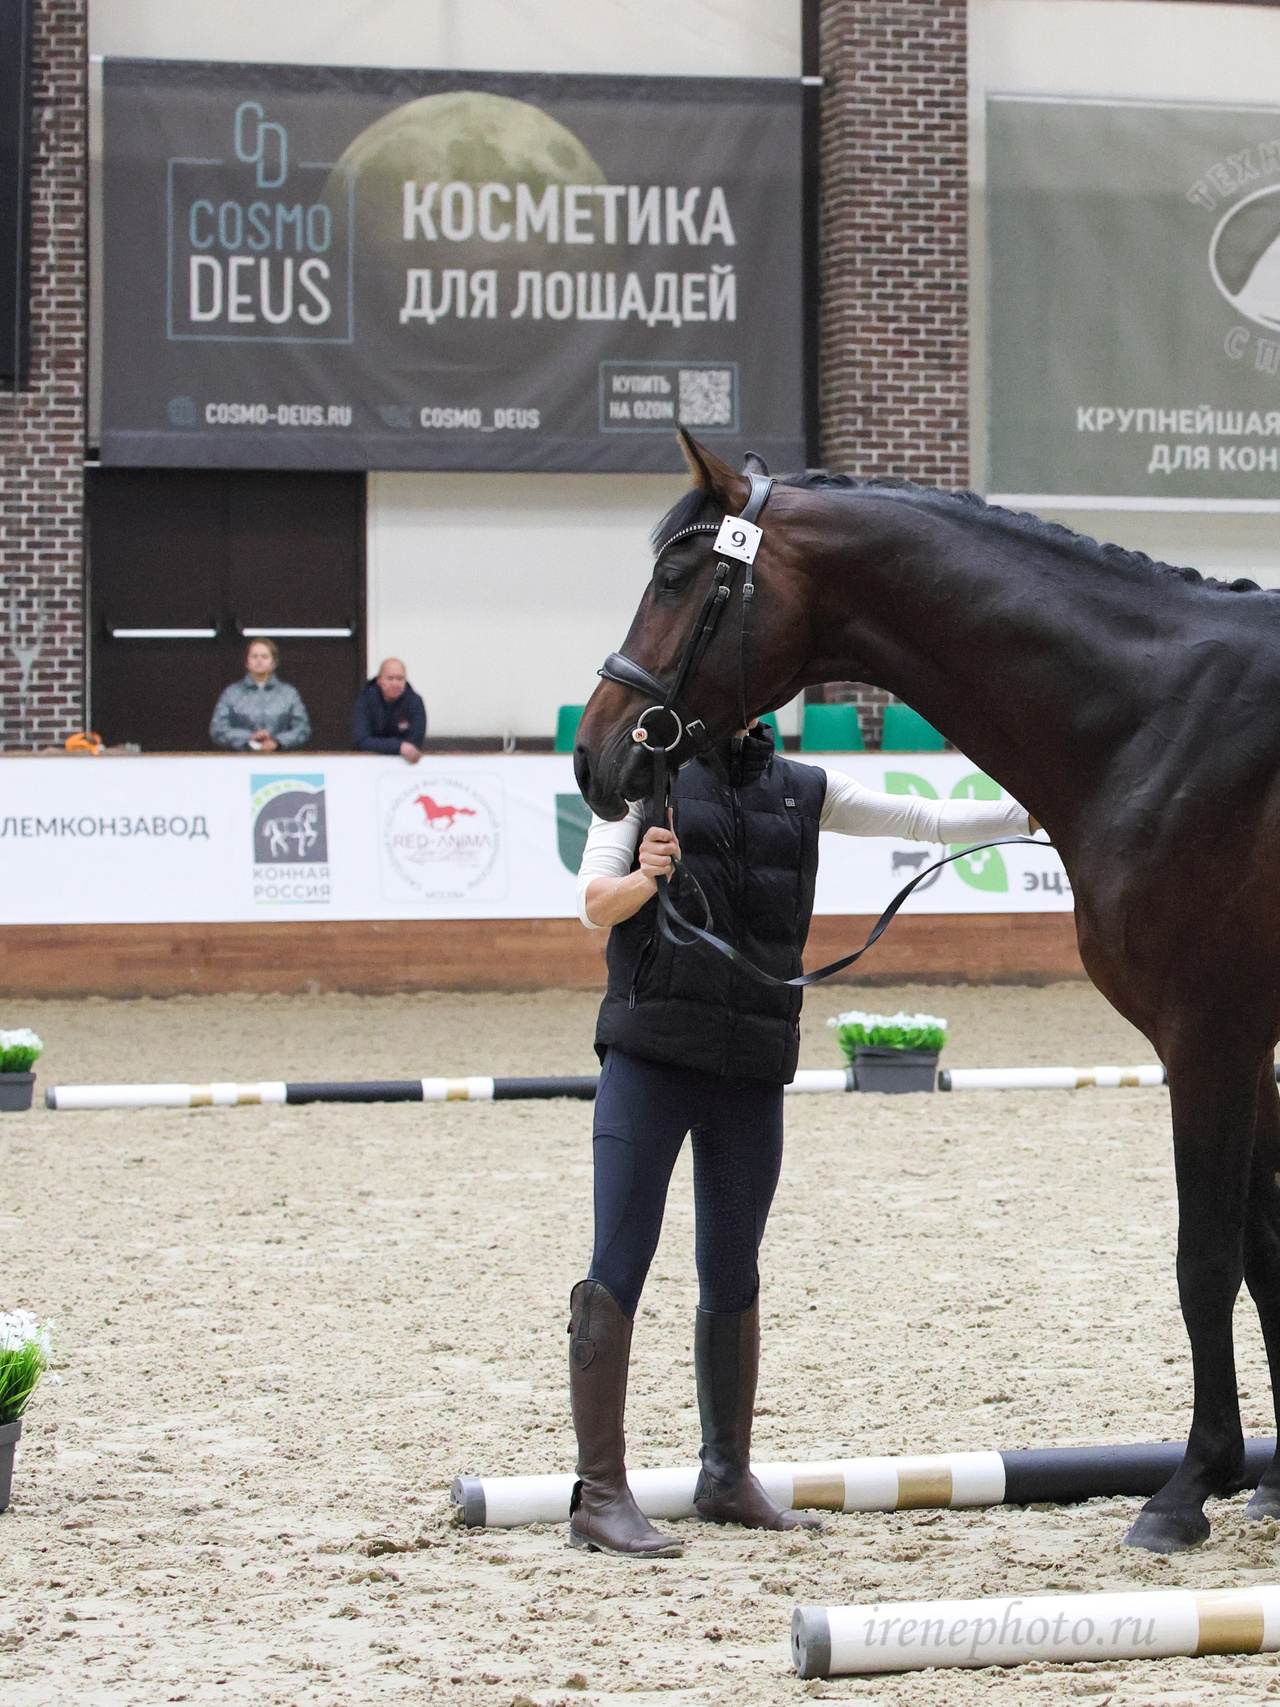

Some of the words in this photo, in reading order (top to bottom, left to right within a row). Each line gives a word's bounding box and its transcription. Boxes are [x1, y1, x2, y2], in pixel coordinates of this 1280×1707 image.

[401, 180, 736, 246] КОСМЕТИКА
[189, 199, 332, 253] COSMO
[189, 255, 332, 325] DEUS
[399, 268, 497, 325] ДЛЯ
[510, 265, 738, 328] ЛОШАДЕЙ
[612, 375, 672, 394] КУПИТЬ
[205, 404, 352, 427] COSMO-DEUS.RU
[420, 408, 540, 432] COSMO_DEUS
[609, 400, 632, 420] НА
[633, 400, 675, 420] OZON
[1147, 443, 1209, 474] ДЛЯ
[731, 530, 747, 547] 9
[0, 816, 210, 841] ЛЕМКОНЗАВОД
[252, 866, 330, 882] КОННАЯ
[1023, 871, 1072, 896] ЭЦ
[253, 884, 330, 899] РОССИЯ
